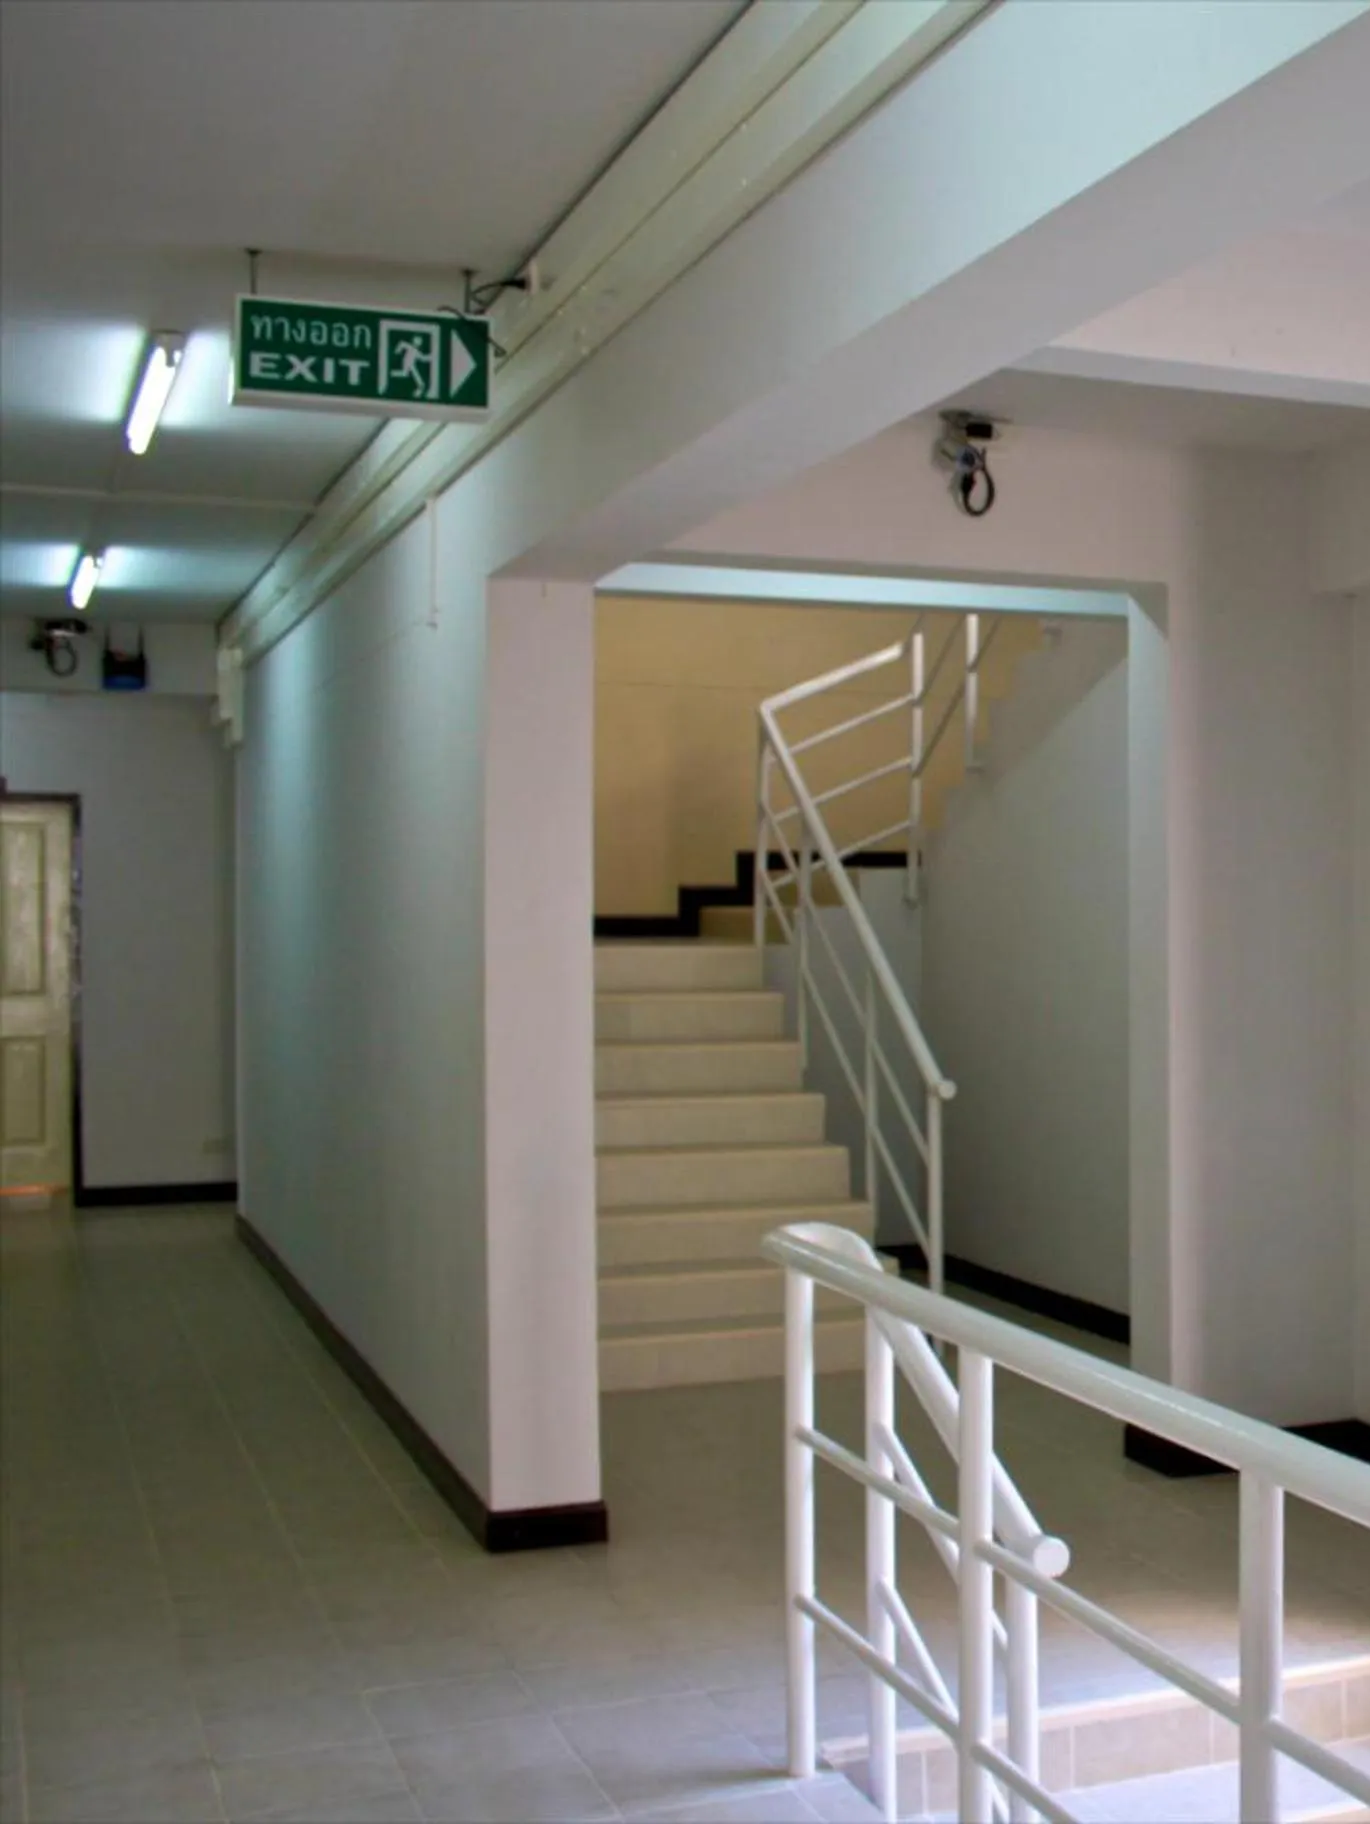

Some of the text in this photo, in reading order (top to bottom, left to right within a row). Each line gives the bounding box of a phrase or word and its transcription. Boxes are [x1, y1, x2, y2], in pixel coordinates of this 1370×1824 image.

[250, 314, 371, 348] ทางออก
[249, 352, 370, 386] EXIT
